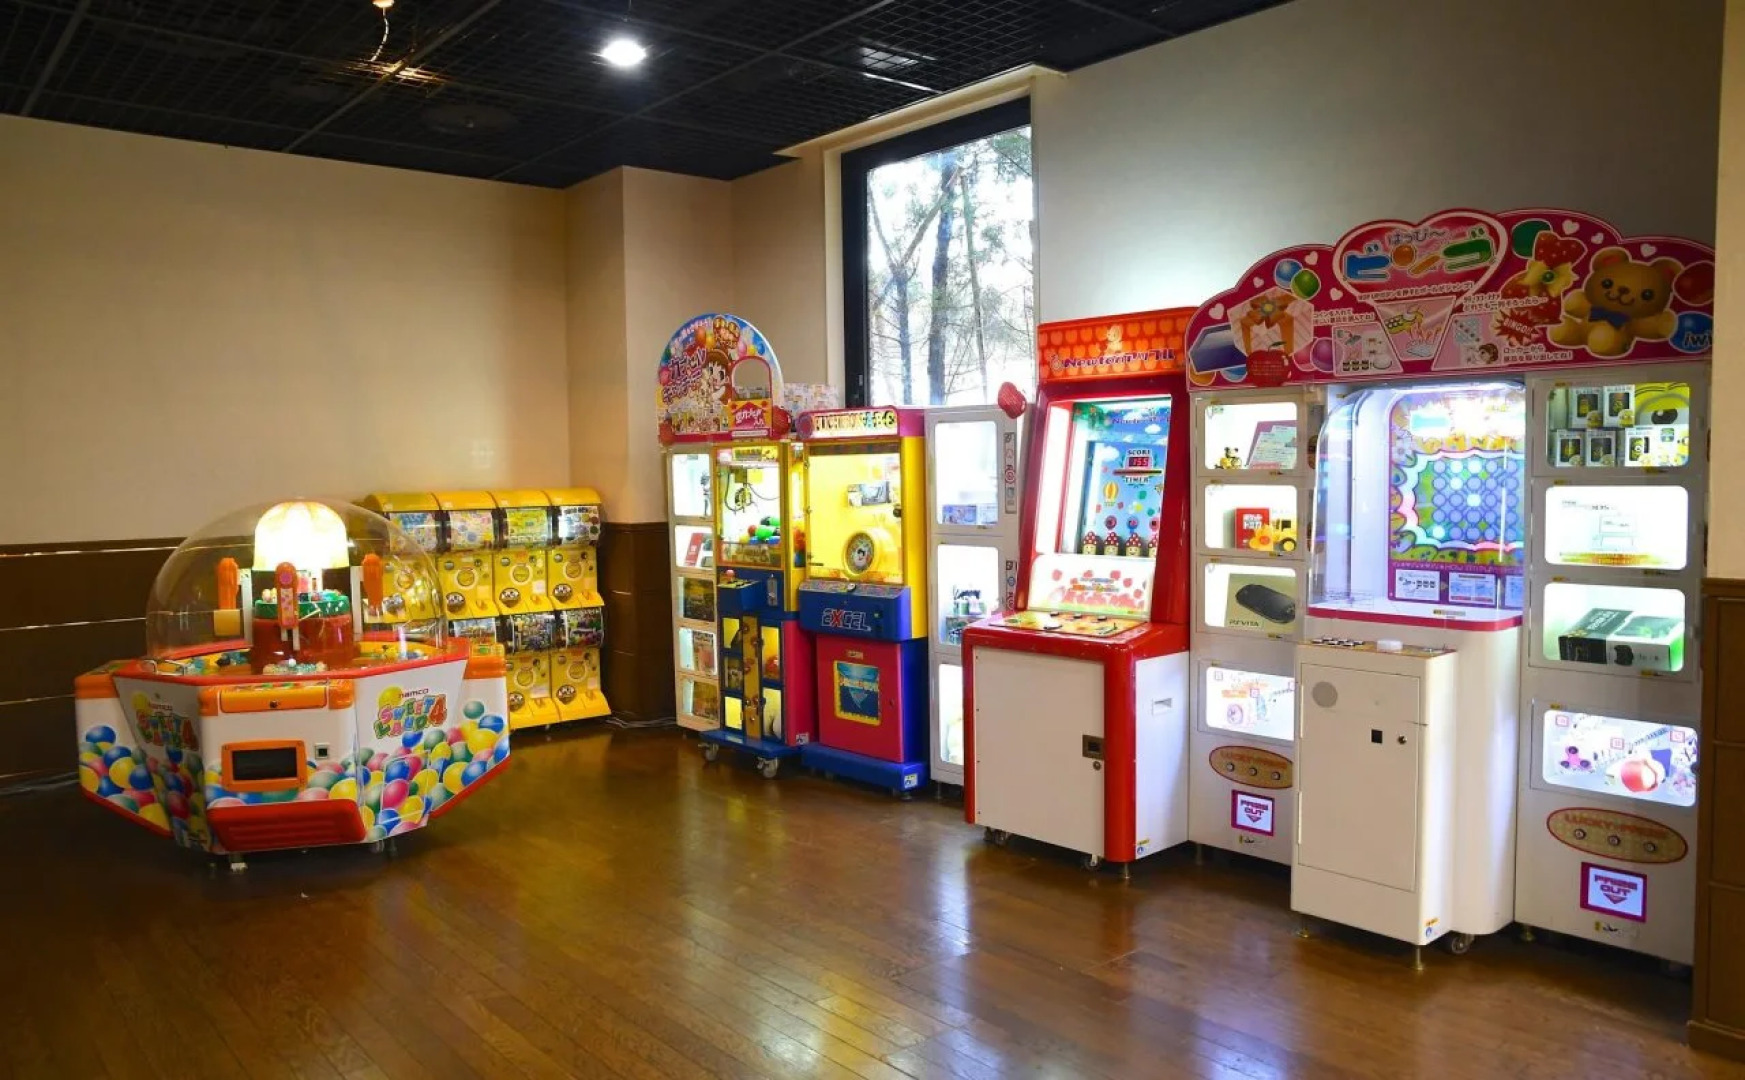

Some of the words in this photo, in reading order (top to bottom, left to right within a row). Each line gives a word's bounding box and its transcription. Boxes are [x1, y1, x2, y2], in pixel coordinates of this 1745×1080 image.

[821, 607, 869, 631] EXCEL
[399, 688, 429, 698] namco
[378, 695, 435, 725] SWEET
[1600, 884, 1632, 897] OUT
